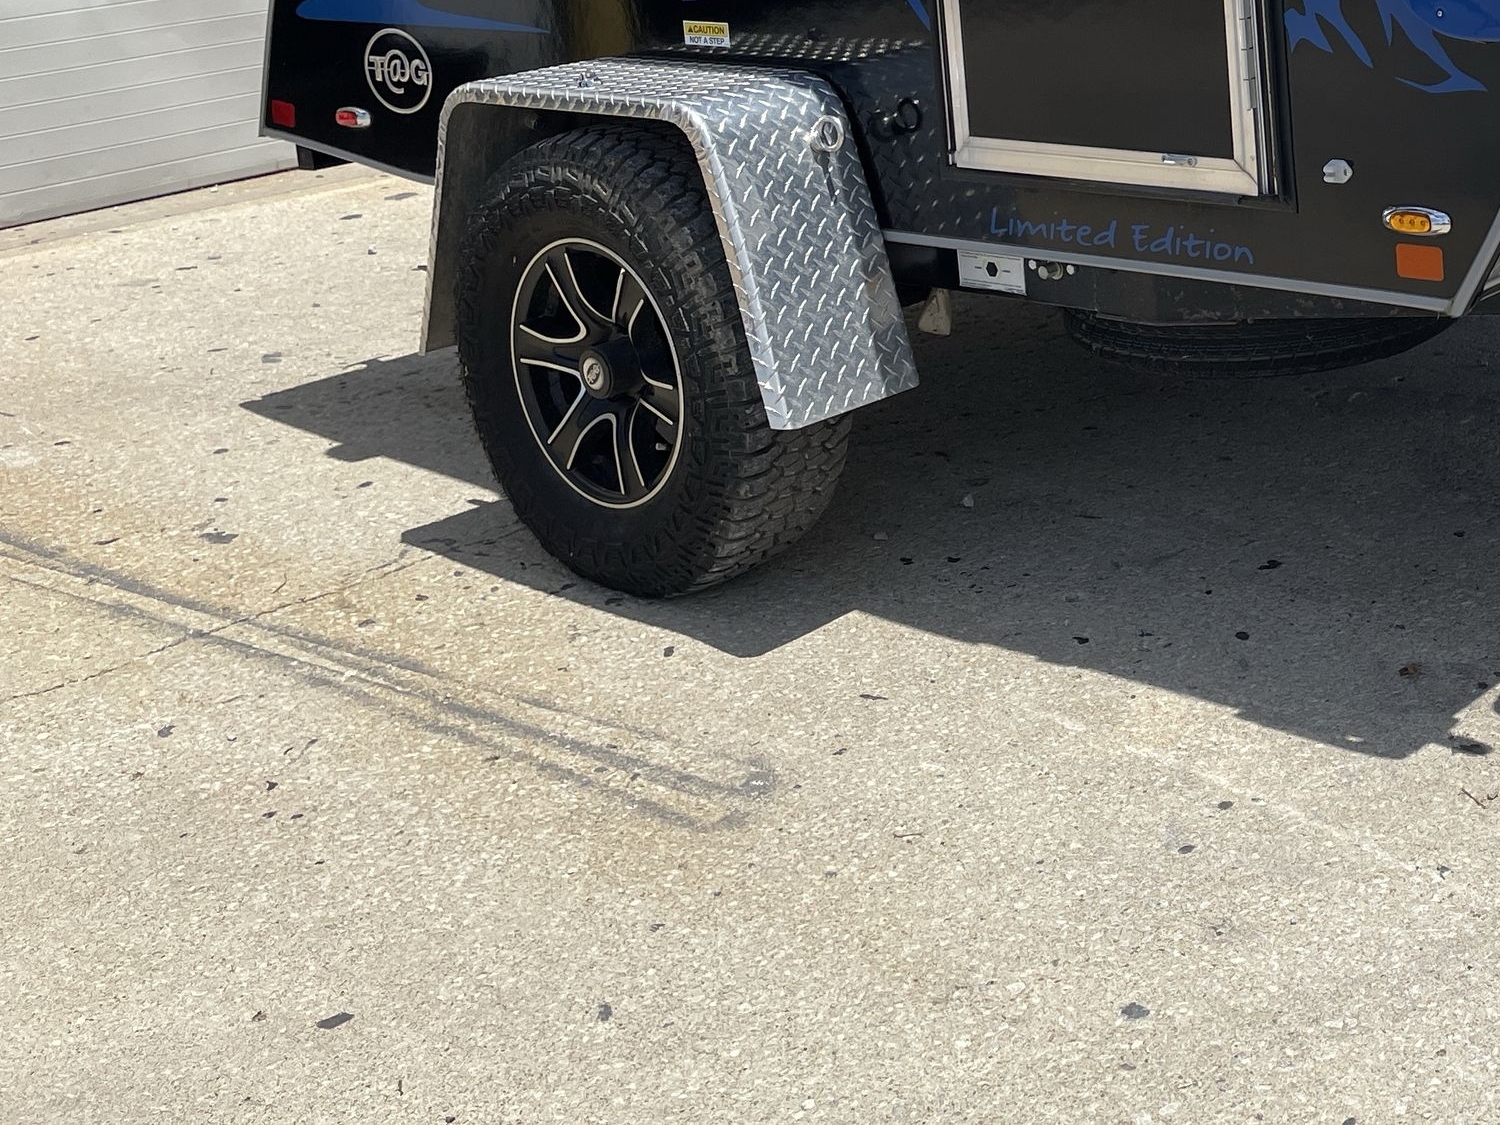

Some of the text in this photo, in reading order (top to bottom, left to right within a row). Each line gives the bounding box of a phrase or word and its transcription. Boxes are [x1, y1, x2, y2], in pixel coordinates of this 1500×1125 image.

[689, 36, 702, 44] NOT
[709, 37, 725, 45] STEP
[693, 25, 725, 35] CAUTION
[368, 49, 428, 95] T@G
[989, 206, 1255, 265] Limited Edition
